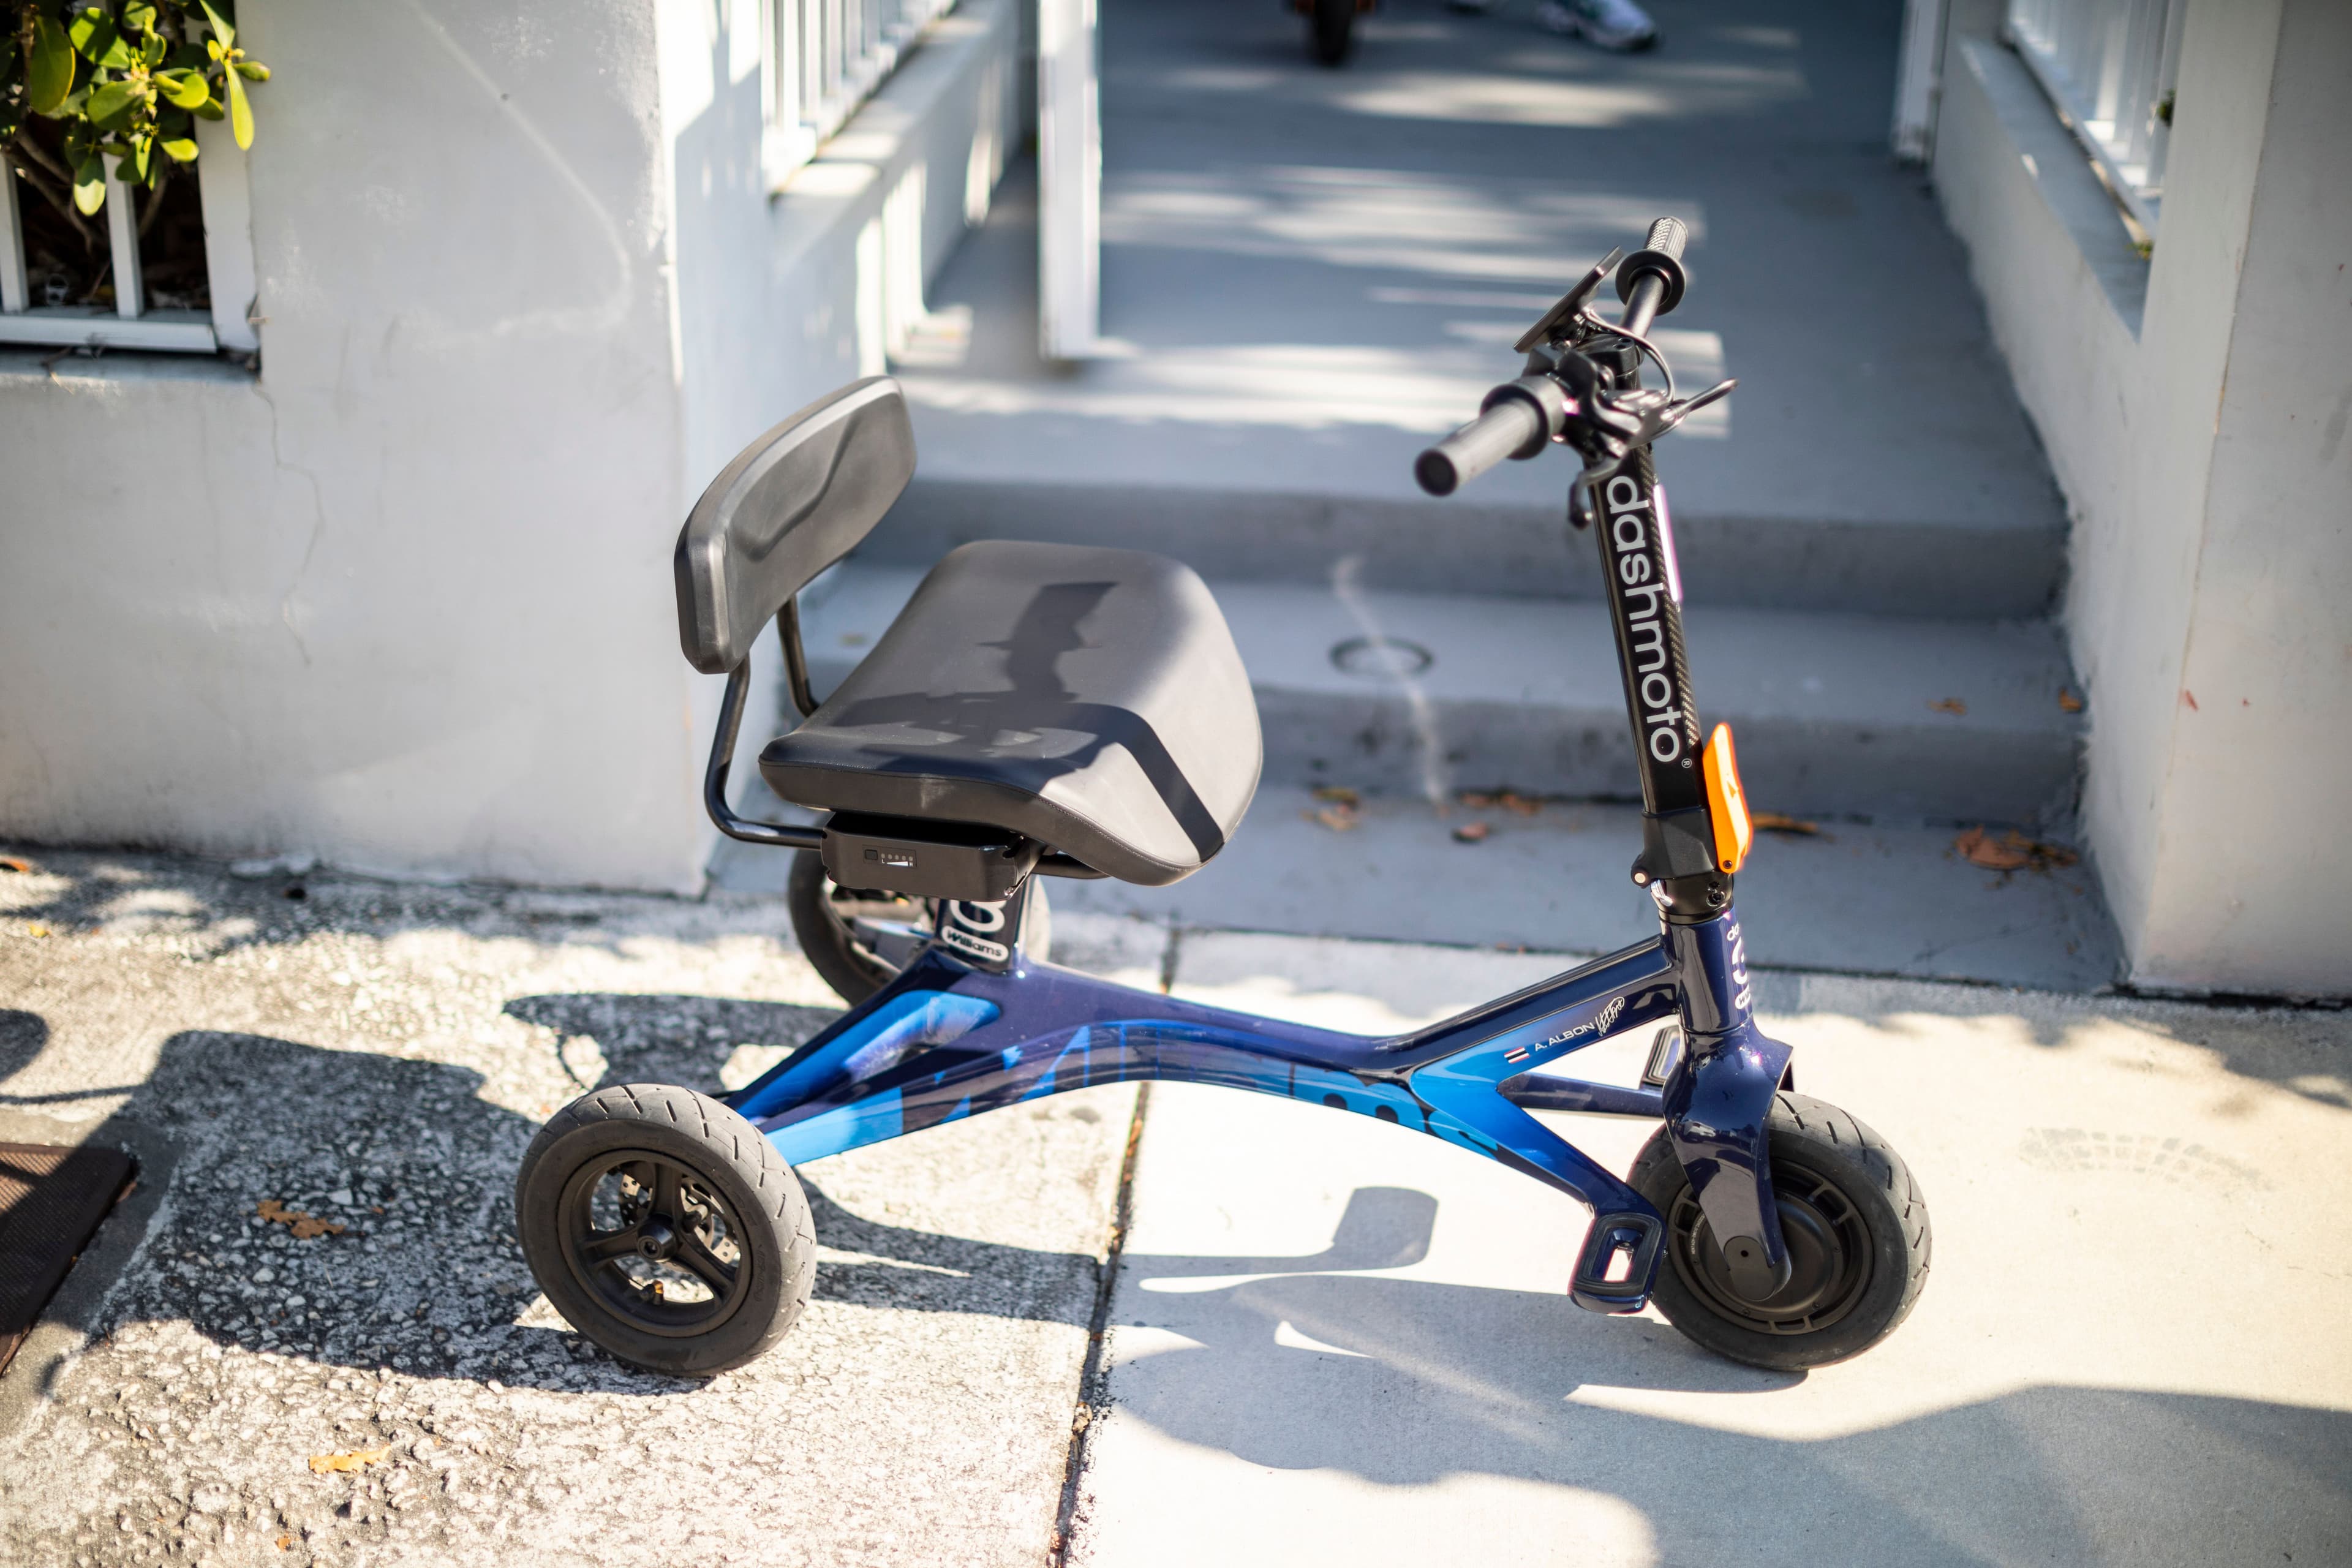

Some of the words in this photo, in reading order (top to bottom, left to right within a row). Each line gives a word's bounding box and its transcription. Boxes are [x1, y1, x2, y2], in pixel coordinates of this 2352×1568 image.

[948, 930, 1003, 957] Williams
[1534, 1042, 1548, 1052] A.
[1548, 1022, 1596, 1046] ALBON
